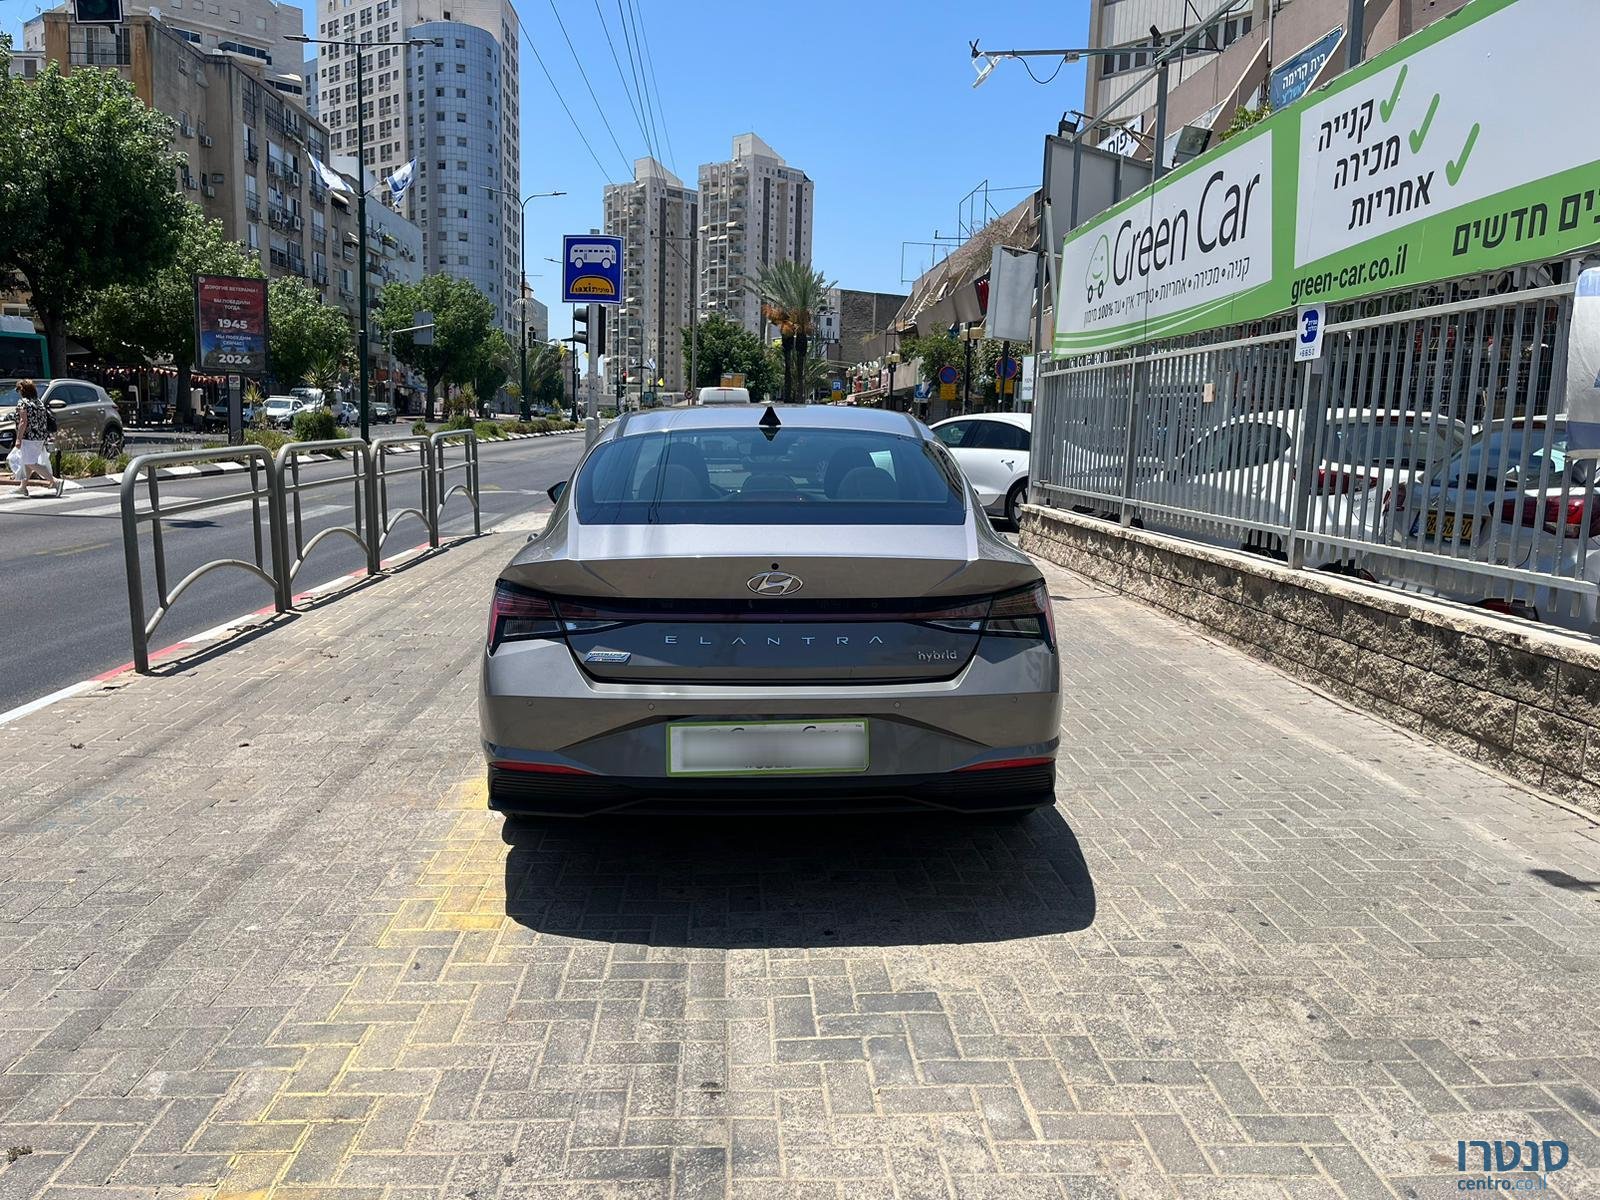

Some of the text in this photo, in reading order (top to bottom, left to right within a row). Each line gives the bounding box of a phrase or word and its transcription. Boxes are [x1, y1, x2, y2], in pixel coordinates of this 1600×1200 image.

[1318, 98, 1374, 152] קנייה
[1333, 135, 1401, 190] מכירה
[1348, 170, 1435, 230] אחריות
[1113, 170, 1260, 286] Green Car
[1452, 203, 1548, 256] חדשים
[1193, 266, 1220, 290] מכירה
[1227, 256, 1250, 281] קניה
[1291, 243, 1408, 305] green-car.co.il
[1159, 277, 1187, 300] אחריות
[218, 318, 248, 329] 1945
[218, 353, 251, 365] 2024
[665, 635, 883, 645] ELANTRA
[918, 649, 957, 663] hybrid
